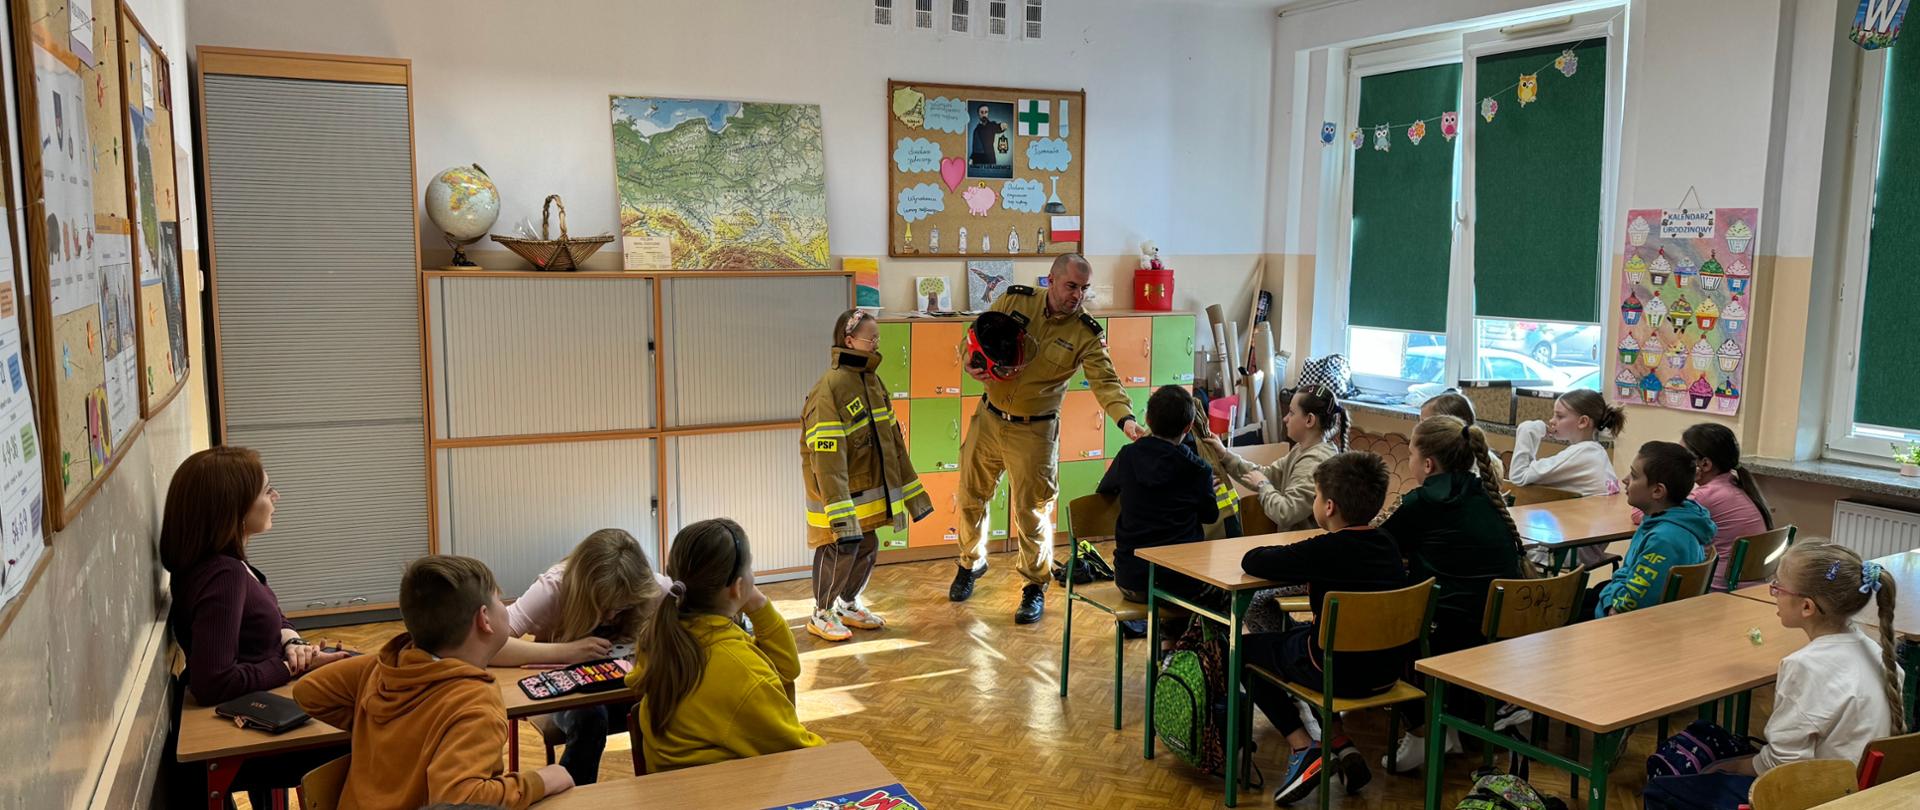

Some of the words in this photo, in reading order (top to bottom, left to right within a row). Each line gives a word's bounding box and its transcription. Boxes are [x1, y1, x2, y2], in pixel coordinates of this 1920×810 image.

[1864, 0, 1902, 33] W
[849, 400, 861, 413] PSP
[817, 441, 834, 450] PSP
[1626, 564, 1658, 598] EAT
